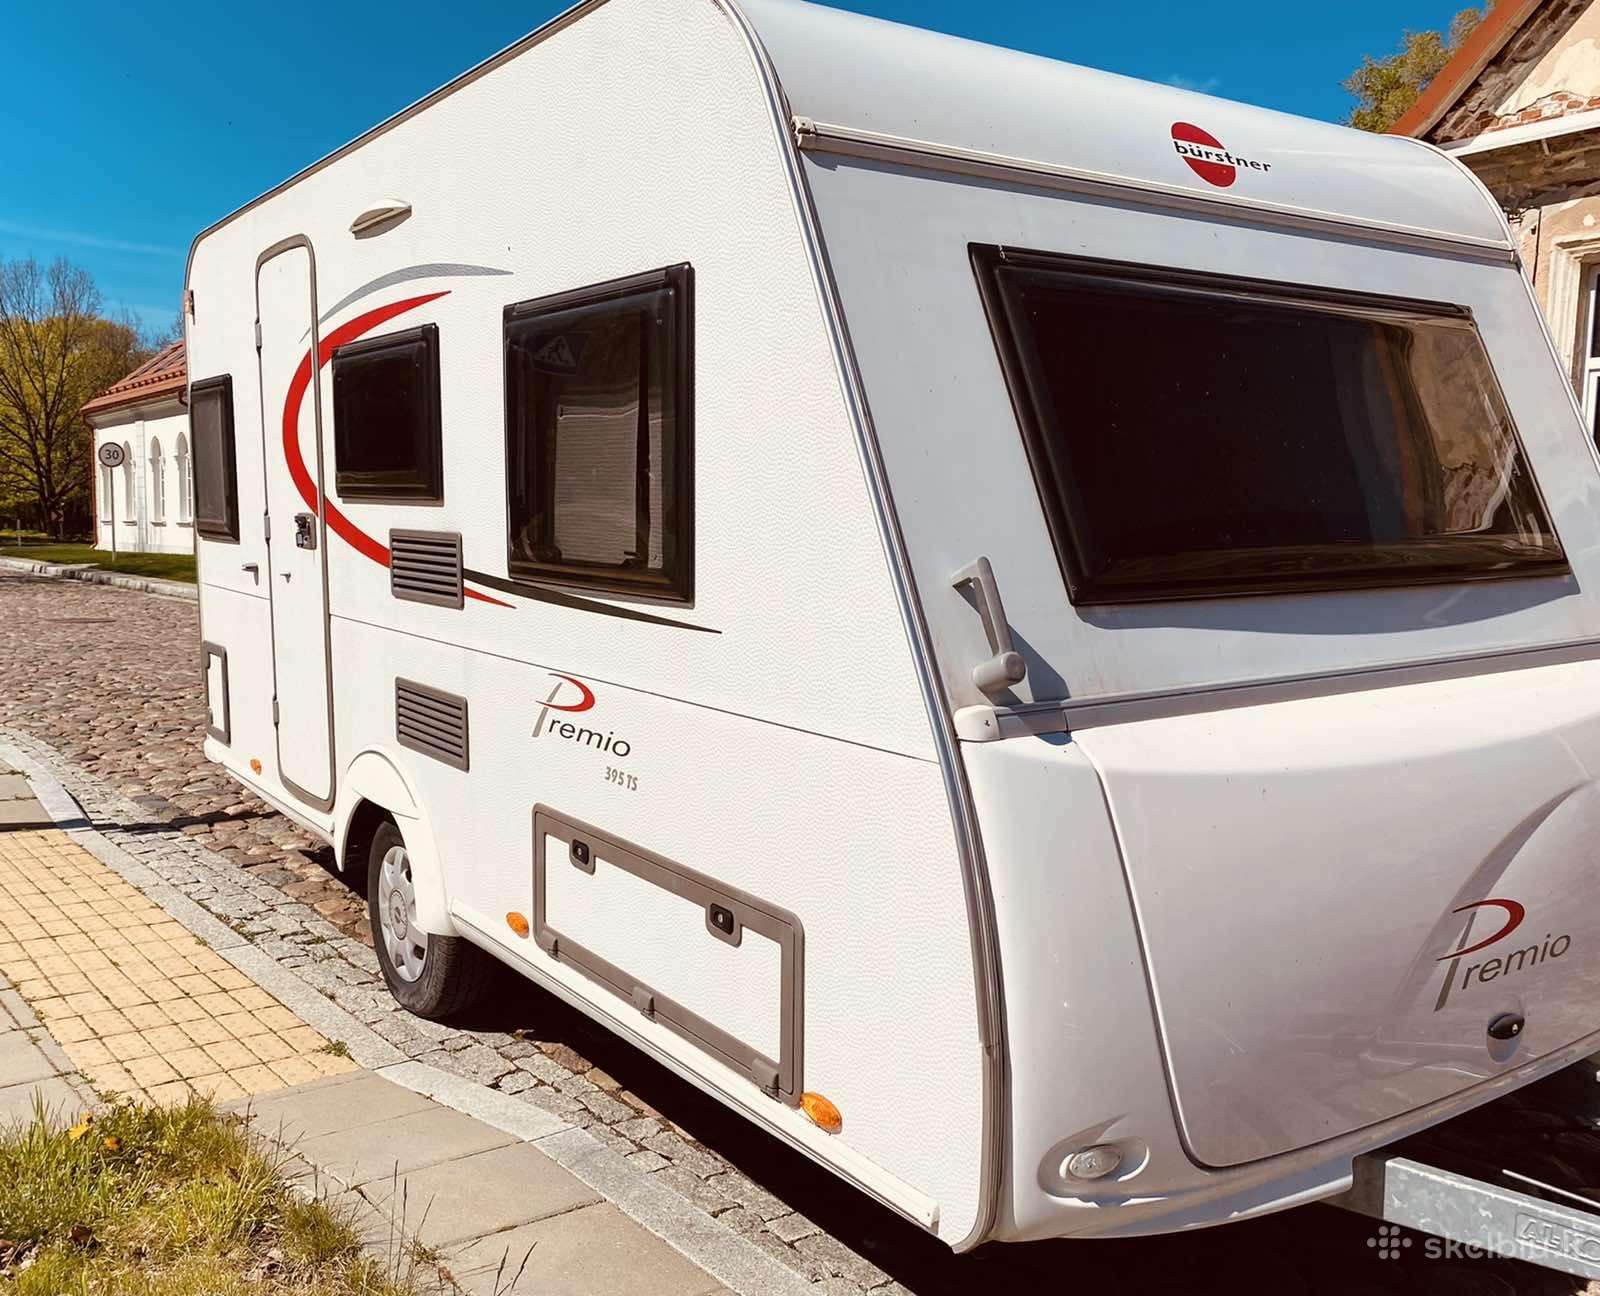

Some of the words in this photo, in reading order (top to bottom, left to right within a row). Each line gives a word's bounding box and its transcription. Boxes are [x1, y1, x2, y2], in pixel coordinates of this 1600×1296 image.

[1173, 140, 1272, 172] bürstner
[105, 449, 120, 460] 30
[531, 672, 631, 758] Premio
[604, 766, 625, 786] 395
[626, 774, 639, 791] TS
[1433, 898, 1572, 1013] Premio
